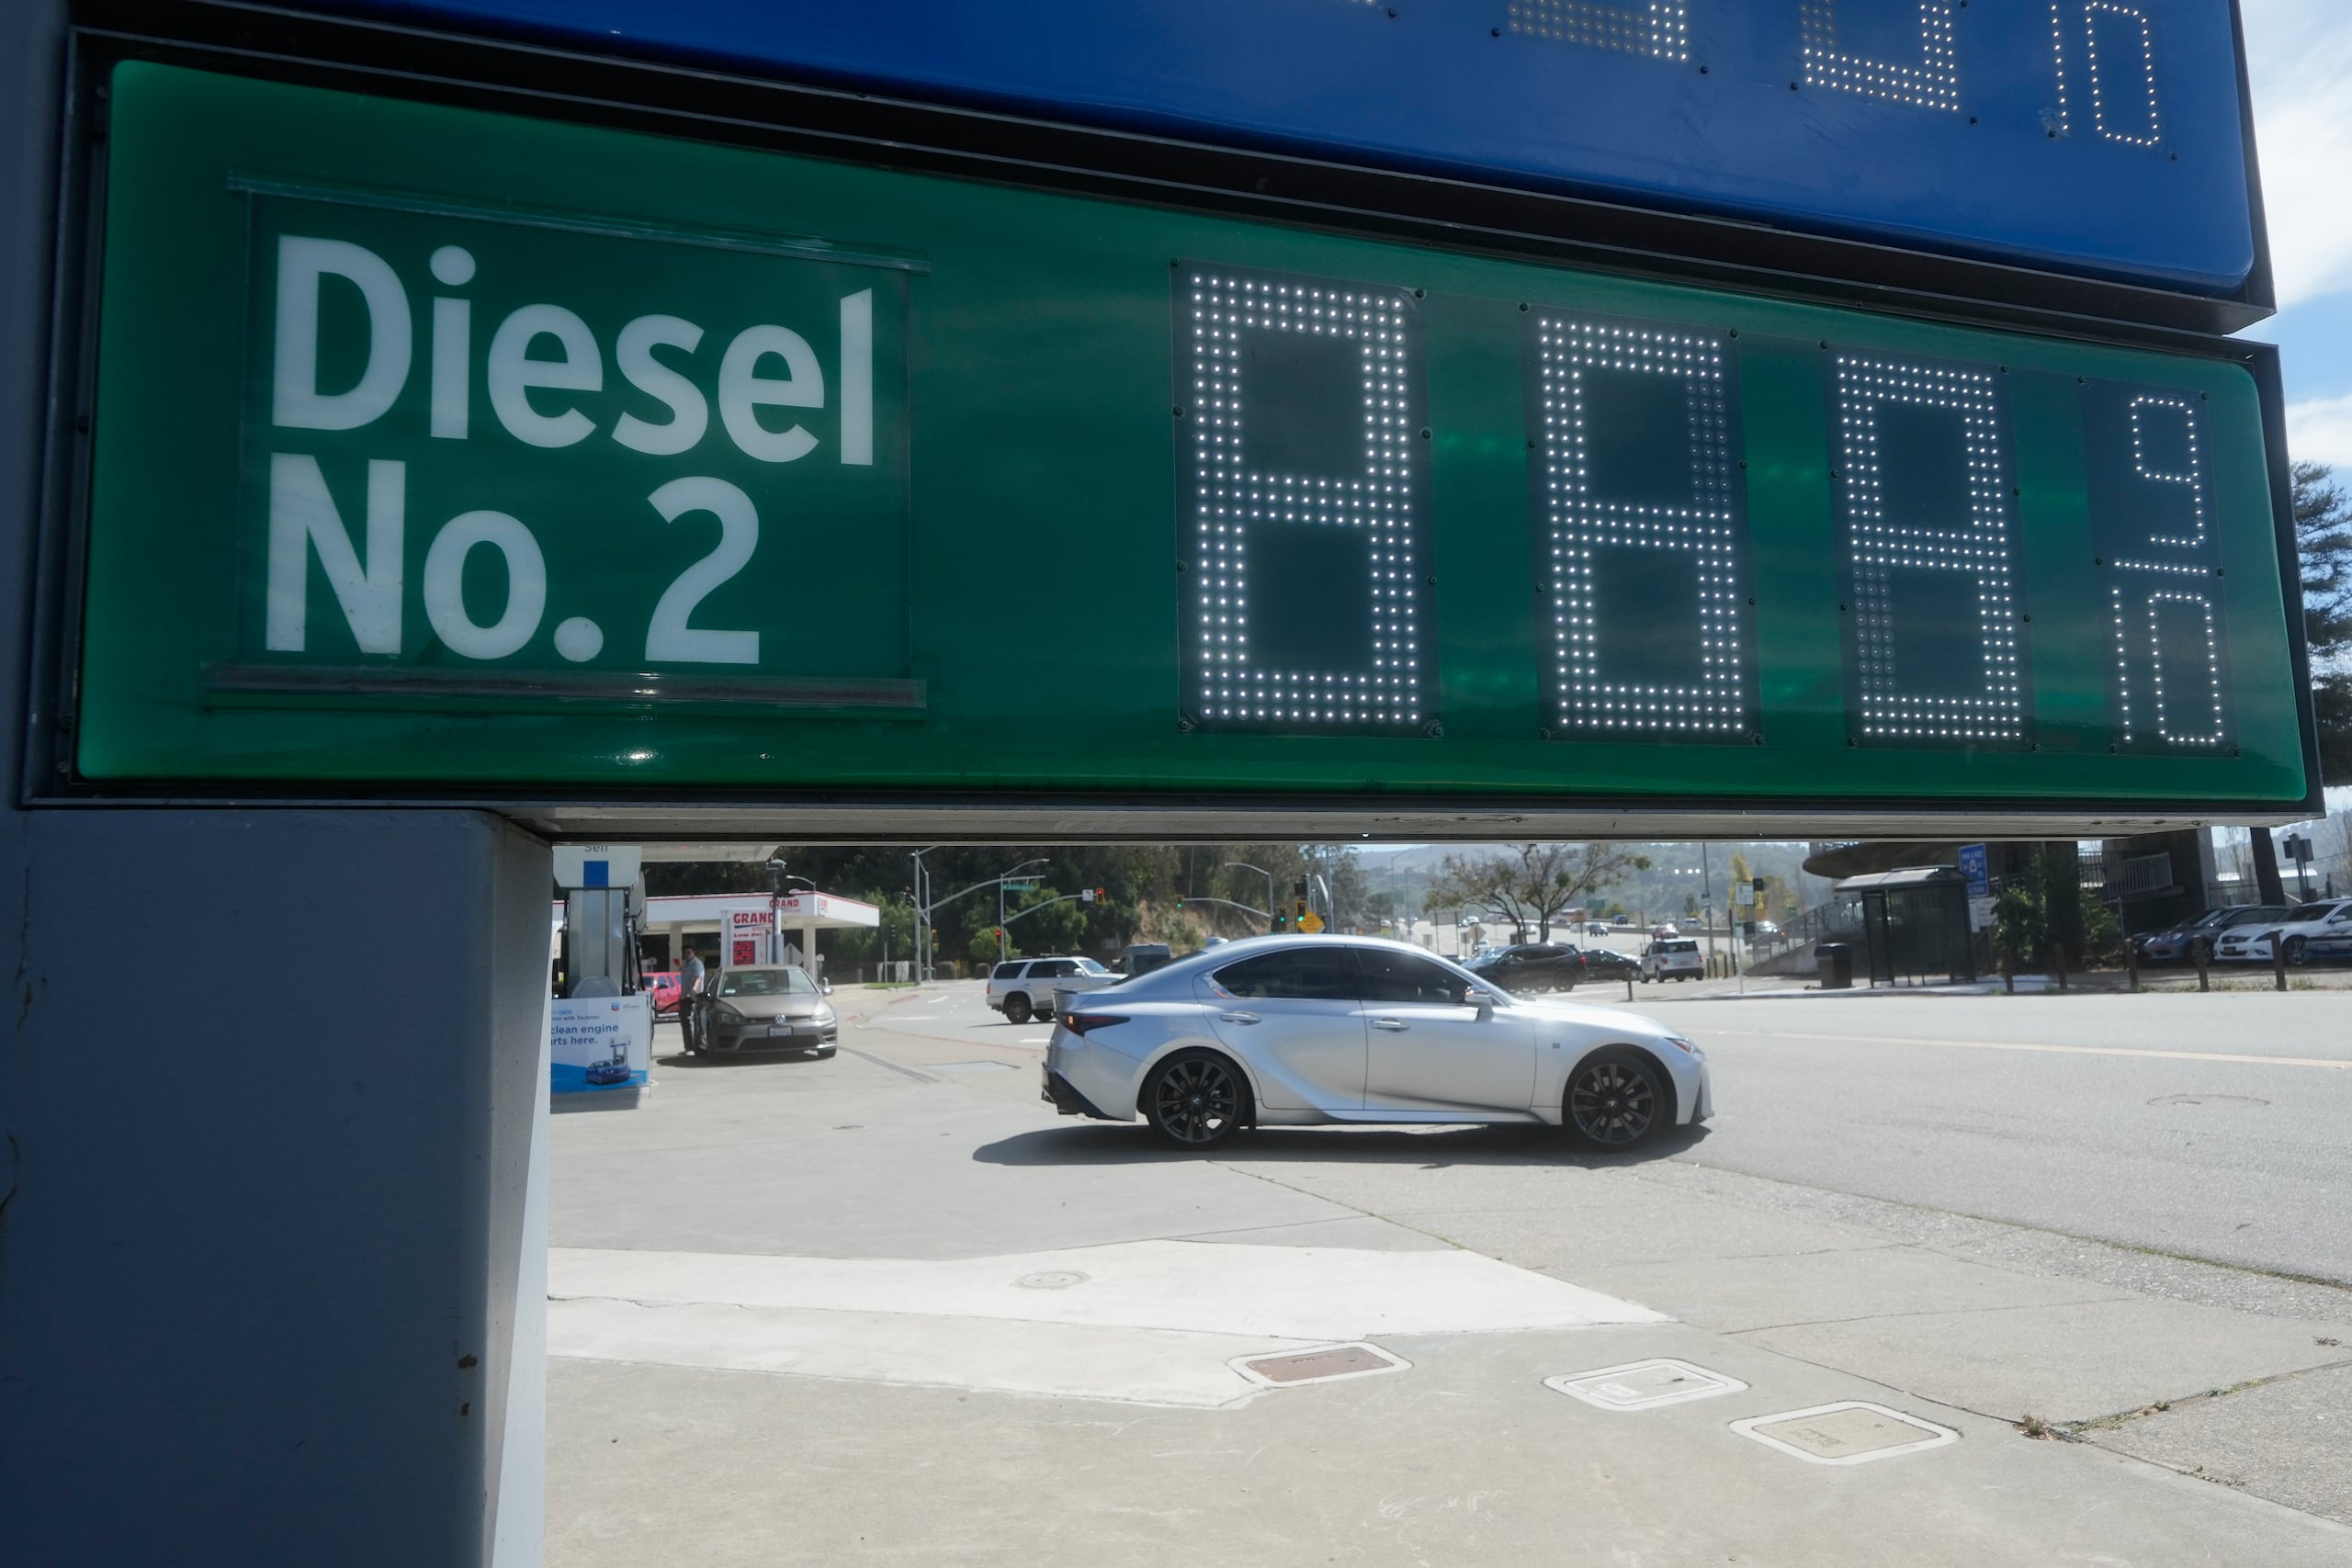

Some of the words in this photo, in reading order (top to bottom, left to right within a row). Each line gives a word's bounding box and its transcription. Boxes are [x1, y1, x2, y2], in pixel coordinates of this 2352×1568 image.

[272, 234, 872, 465] Diesel
[733, 912, 775, 924] GRAND
[550, 1025, 578, 1034] clean
[581, 1024, 619, 1034] engine
[571, 1036, 598, 1045] here.
